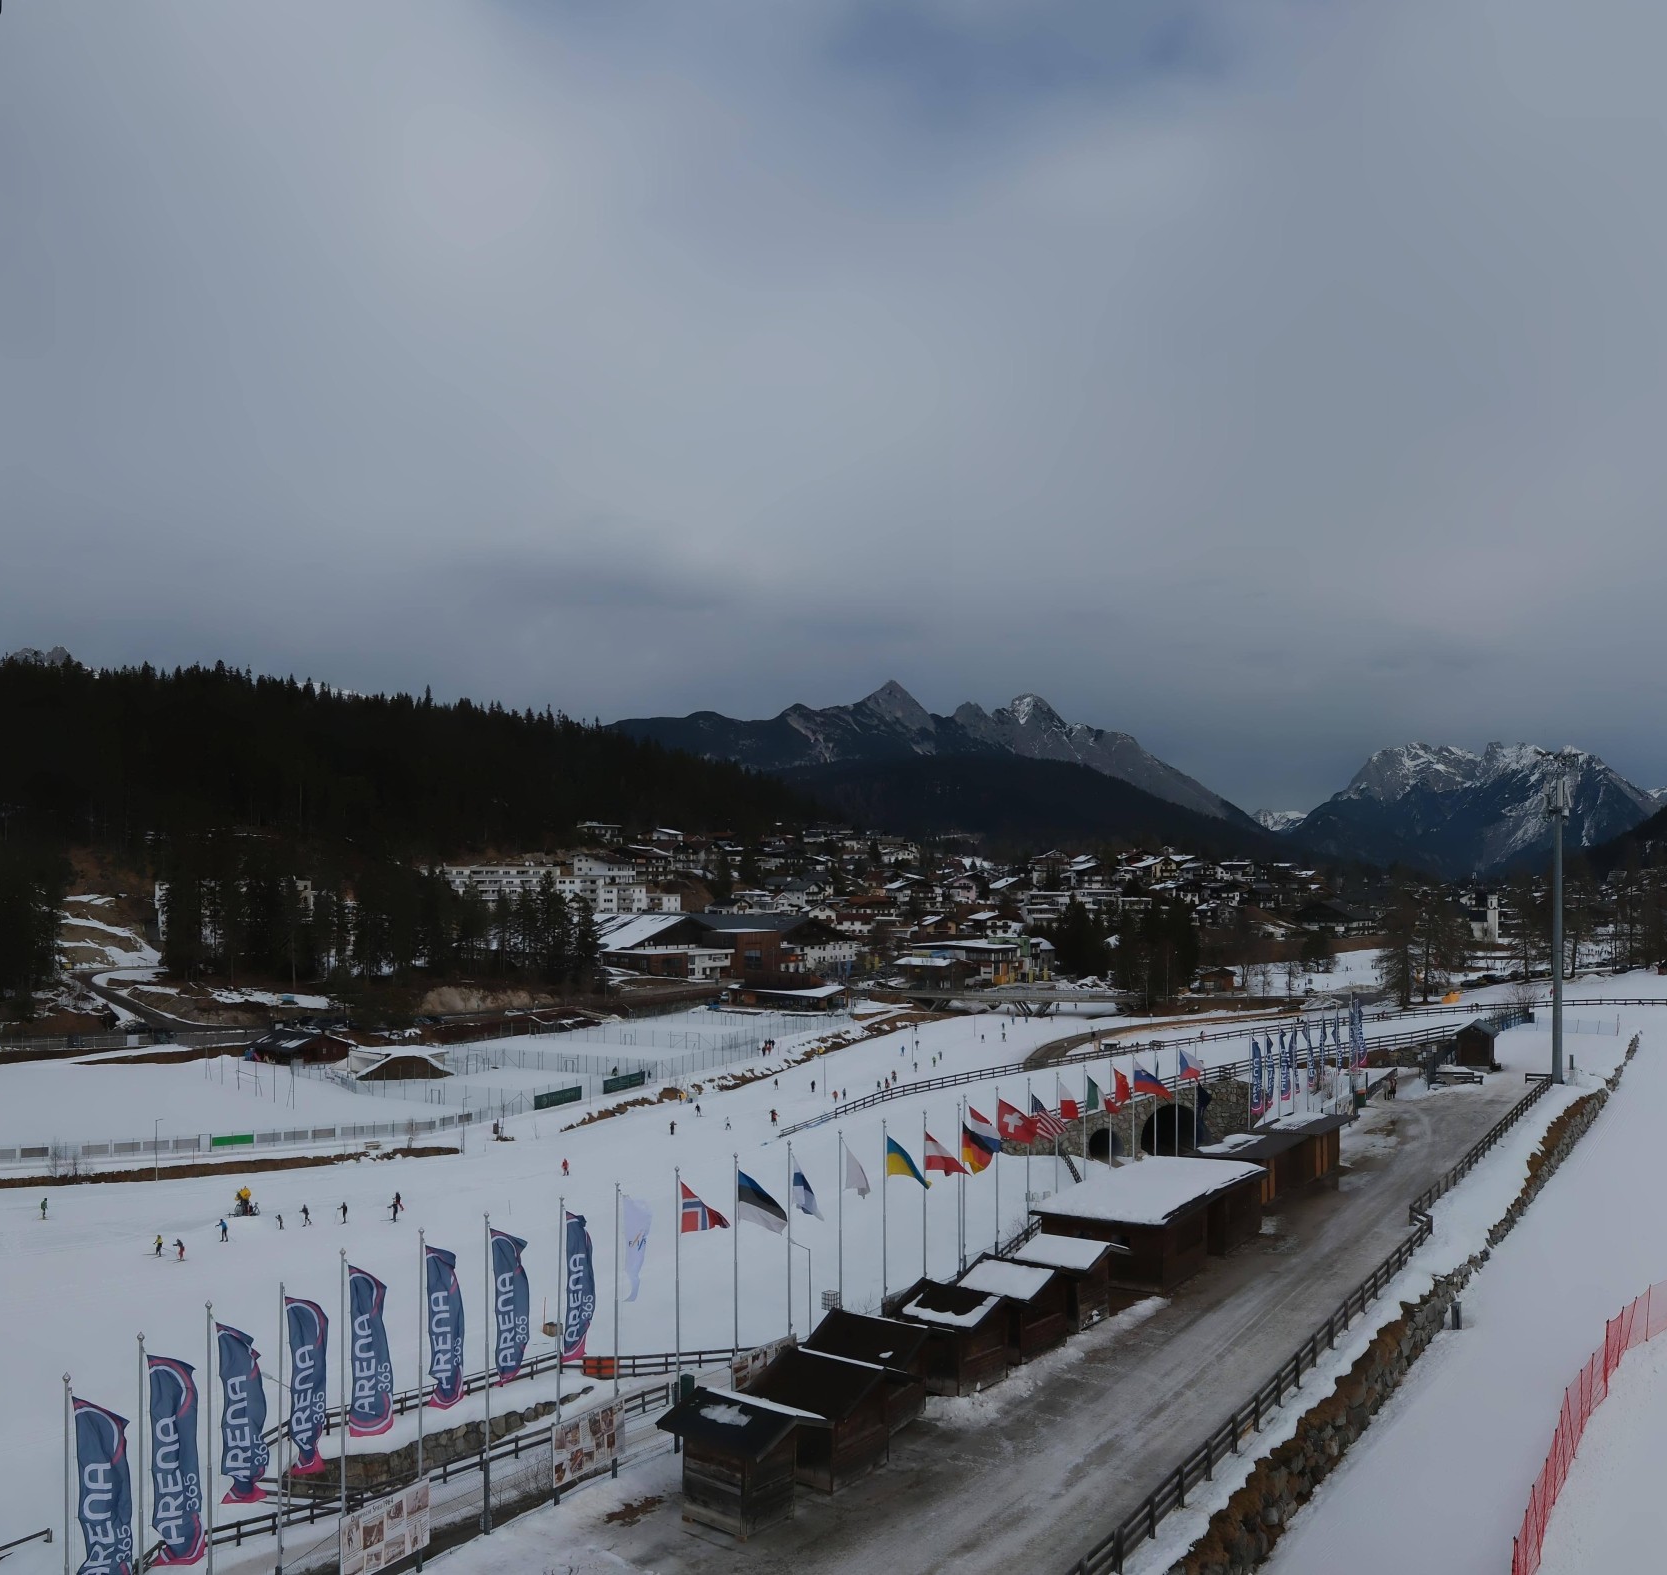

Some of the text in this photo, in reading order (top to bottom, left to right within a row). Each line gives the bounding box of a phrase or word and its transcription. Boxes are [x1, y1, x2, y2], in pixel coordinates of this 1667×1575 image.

[565, 1253, 586, 1341] ARENA
[582, 1294, 594, 1320] 365
[496, 1271, 515, 1367] ARENA
[515, 1315, 528, 1343] 365
[354, 1313, 376, 1415] ARENA
[378, 1362, 391, 1392] 365
[291, 1344, 314, 1450] ARENA
[313, 1391, 325, 1423] 365
[225, 1375, 250, 1482] ARENA
[253, 1434, 268, 1466] 365
[156, 1414, 185, 1545] ARENA
[183, 1472, 199, 1511] 365
[116, 1525, 131, 1563] 365
